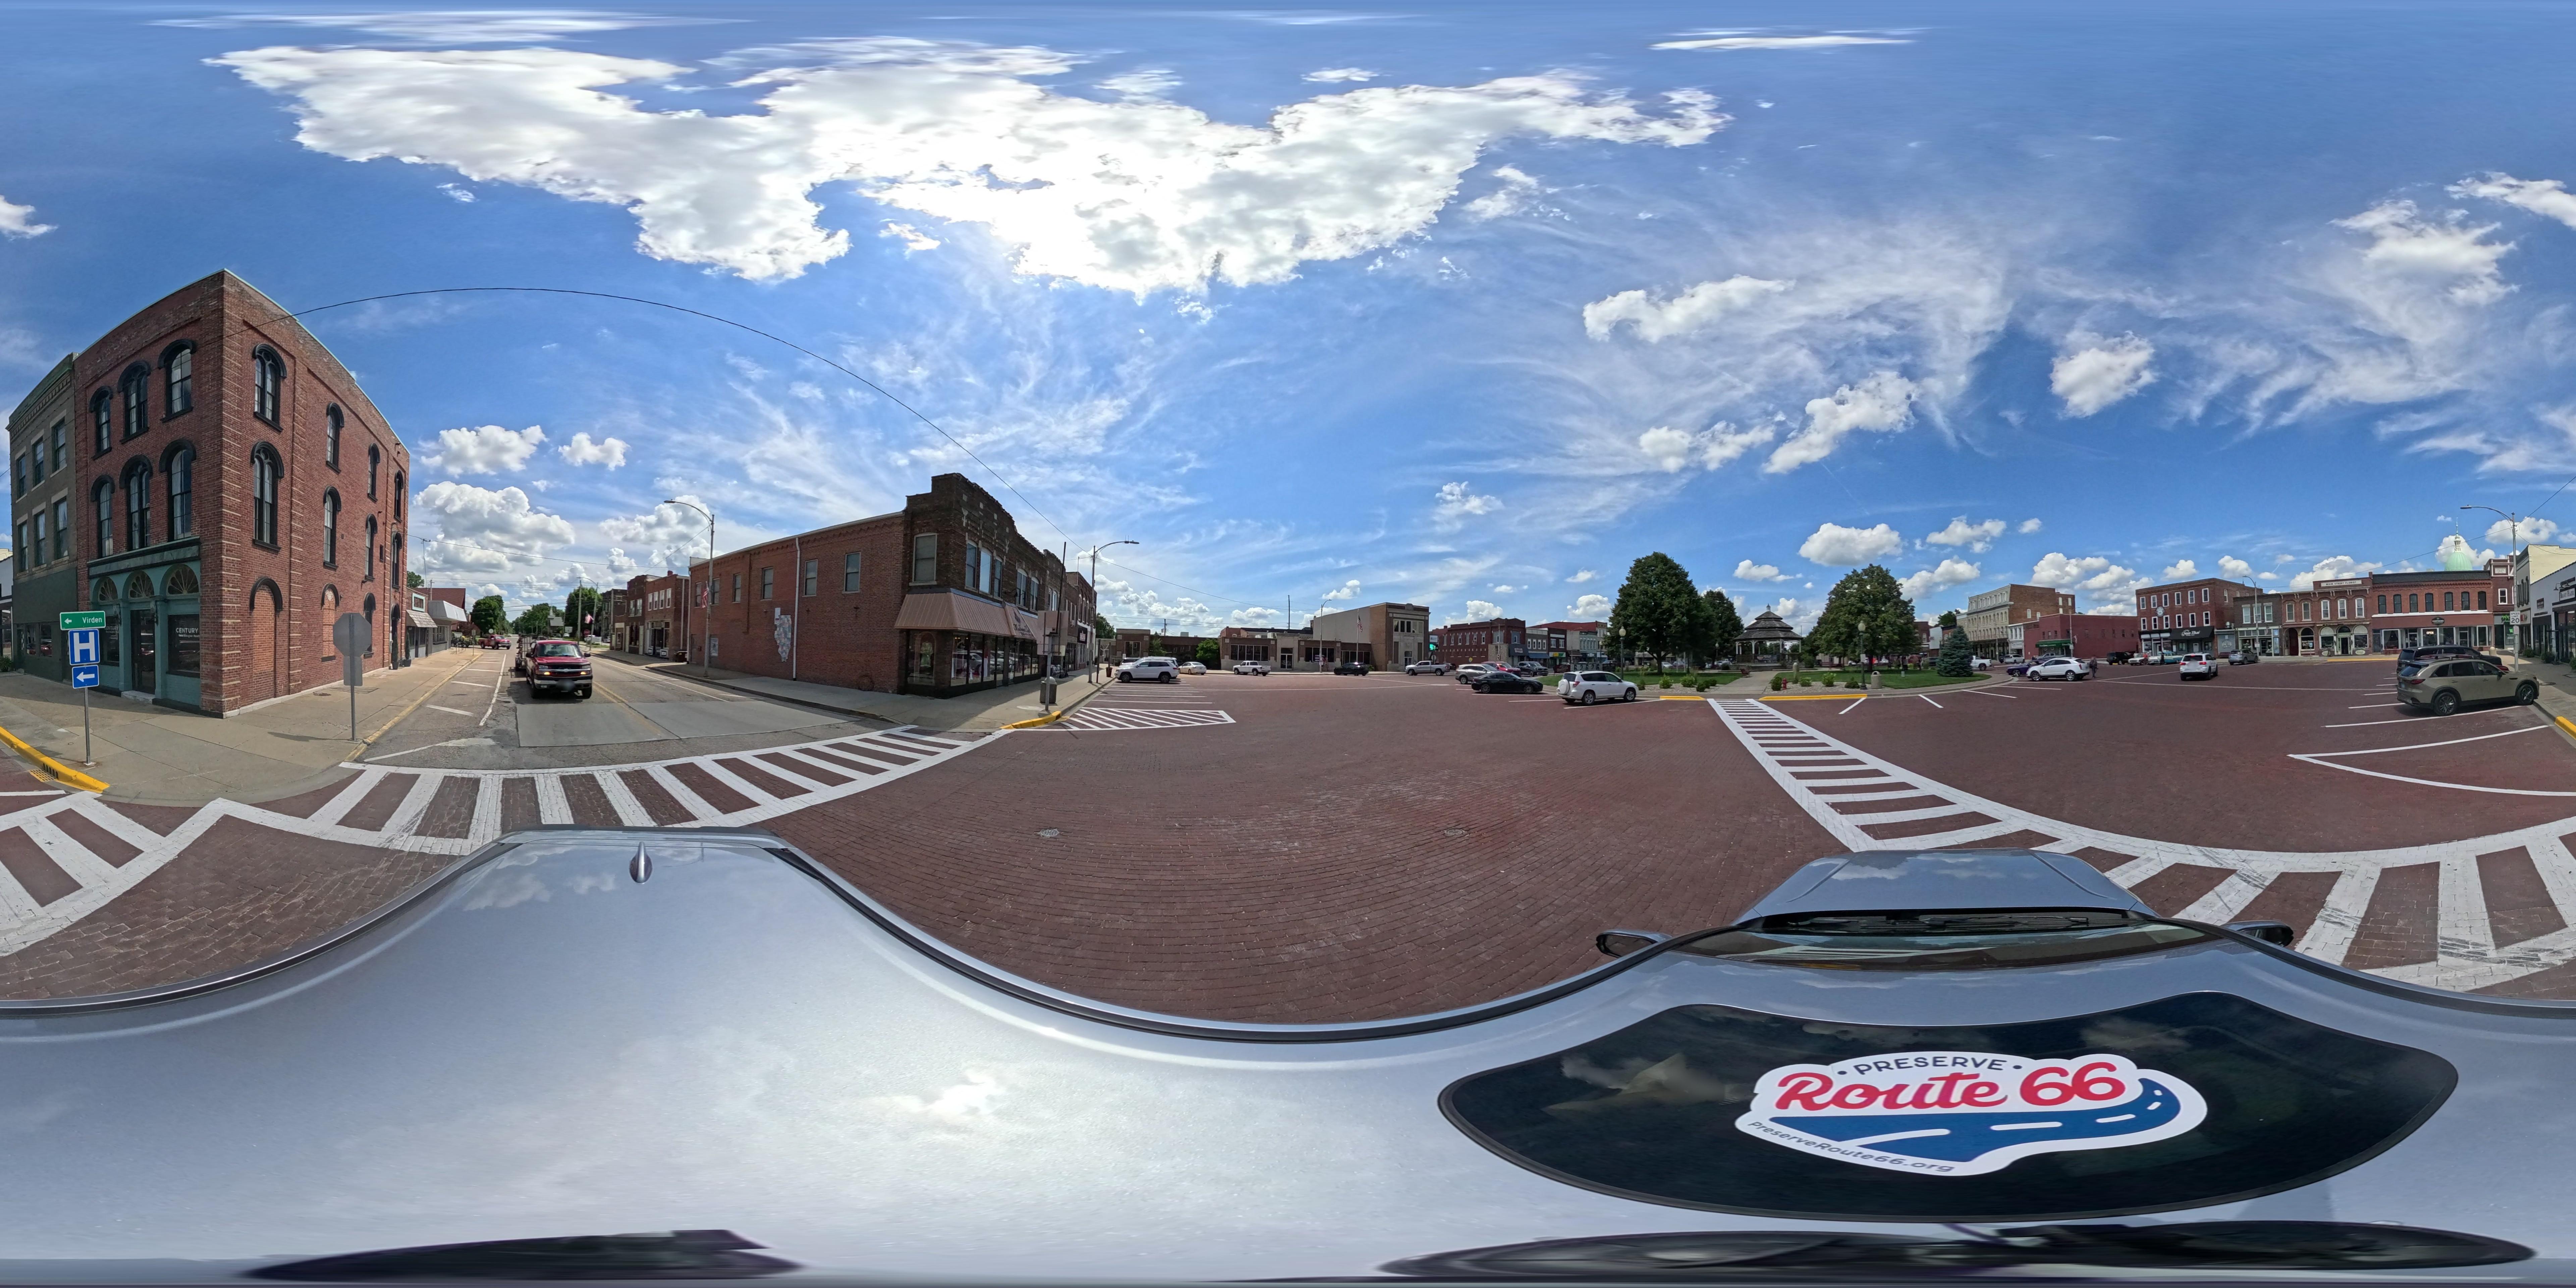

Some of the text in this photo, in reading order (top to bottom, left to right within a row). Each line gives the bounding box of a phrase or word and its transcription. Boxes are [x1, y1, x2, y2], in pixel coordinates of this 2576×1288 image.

[73, 632, 96, 662] H
[1853, 1056, 2007, 1075] PRESERVE
[1775, 1062, 2126, 1111] Route 66
[1748, 1121, 1955, 1173] PreserveRoute66.org
